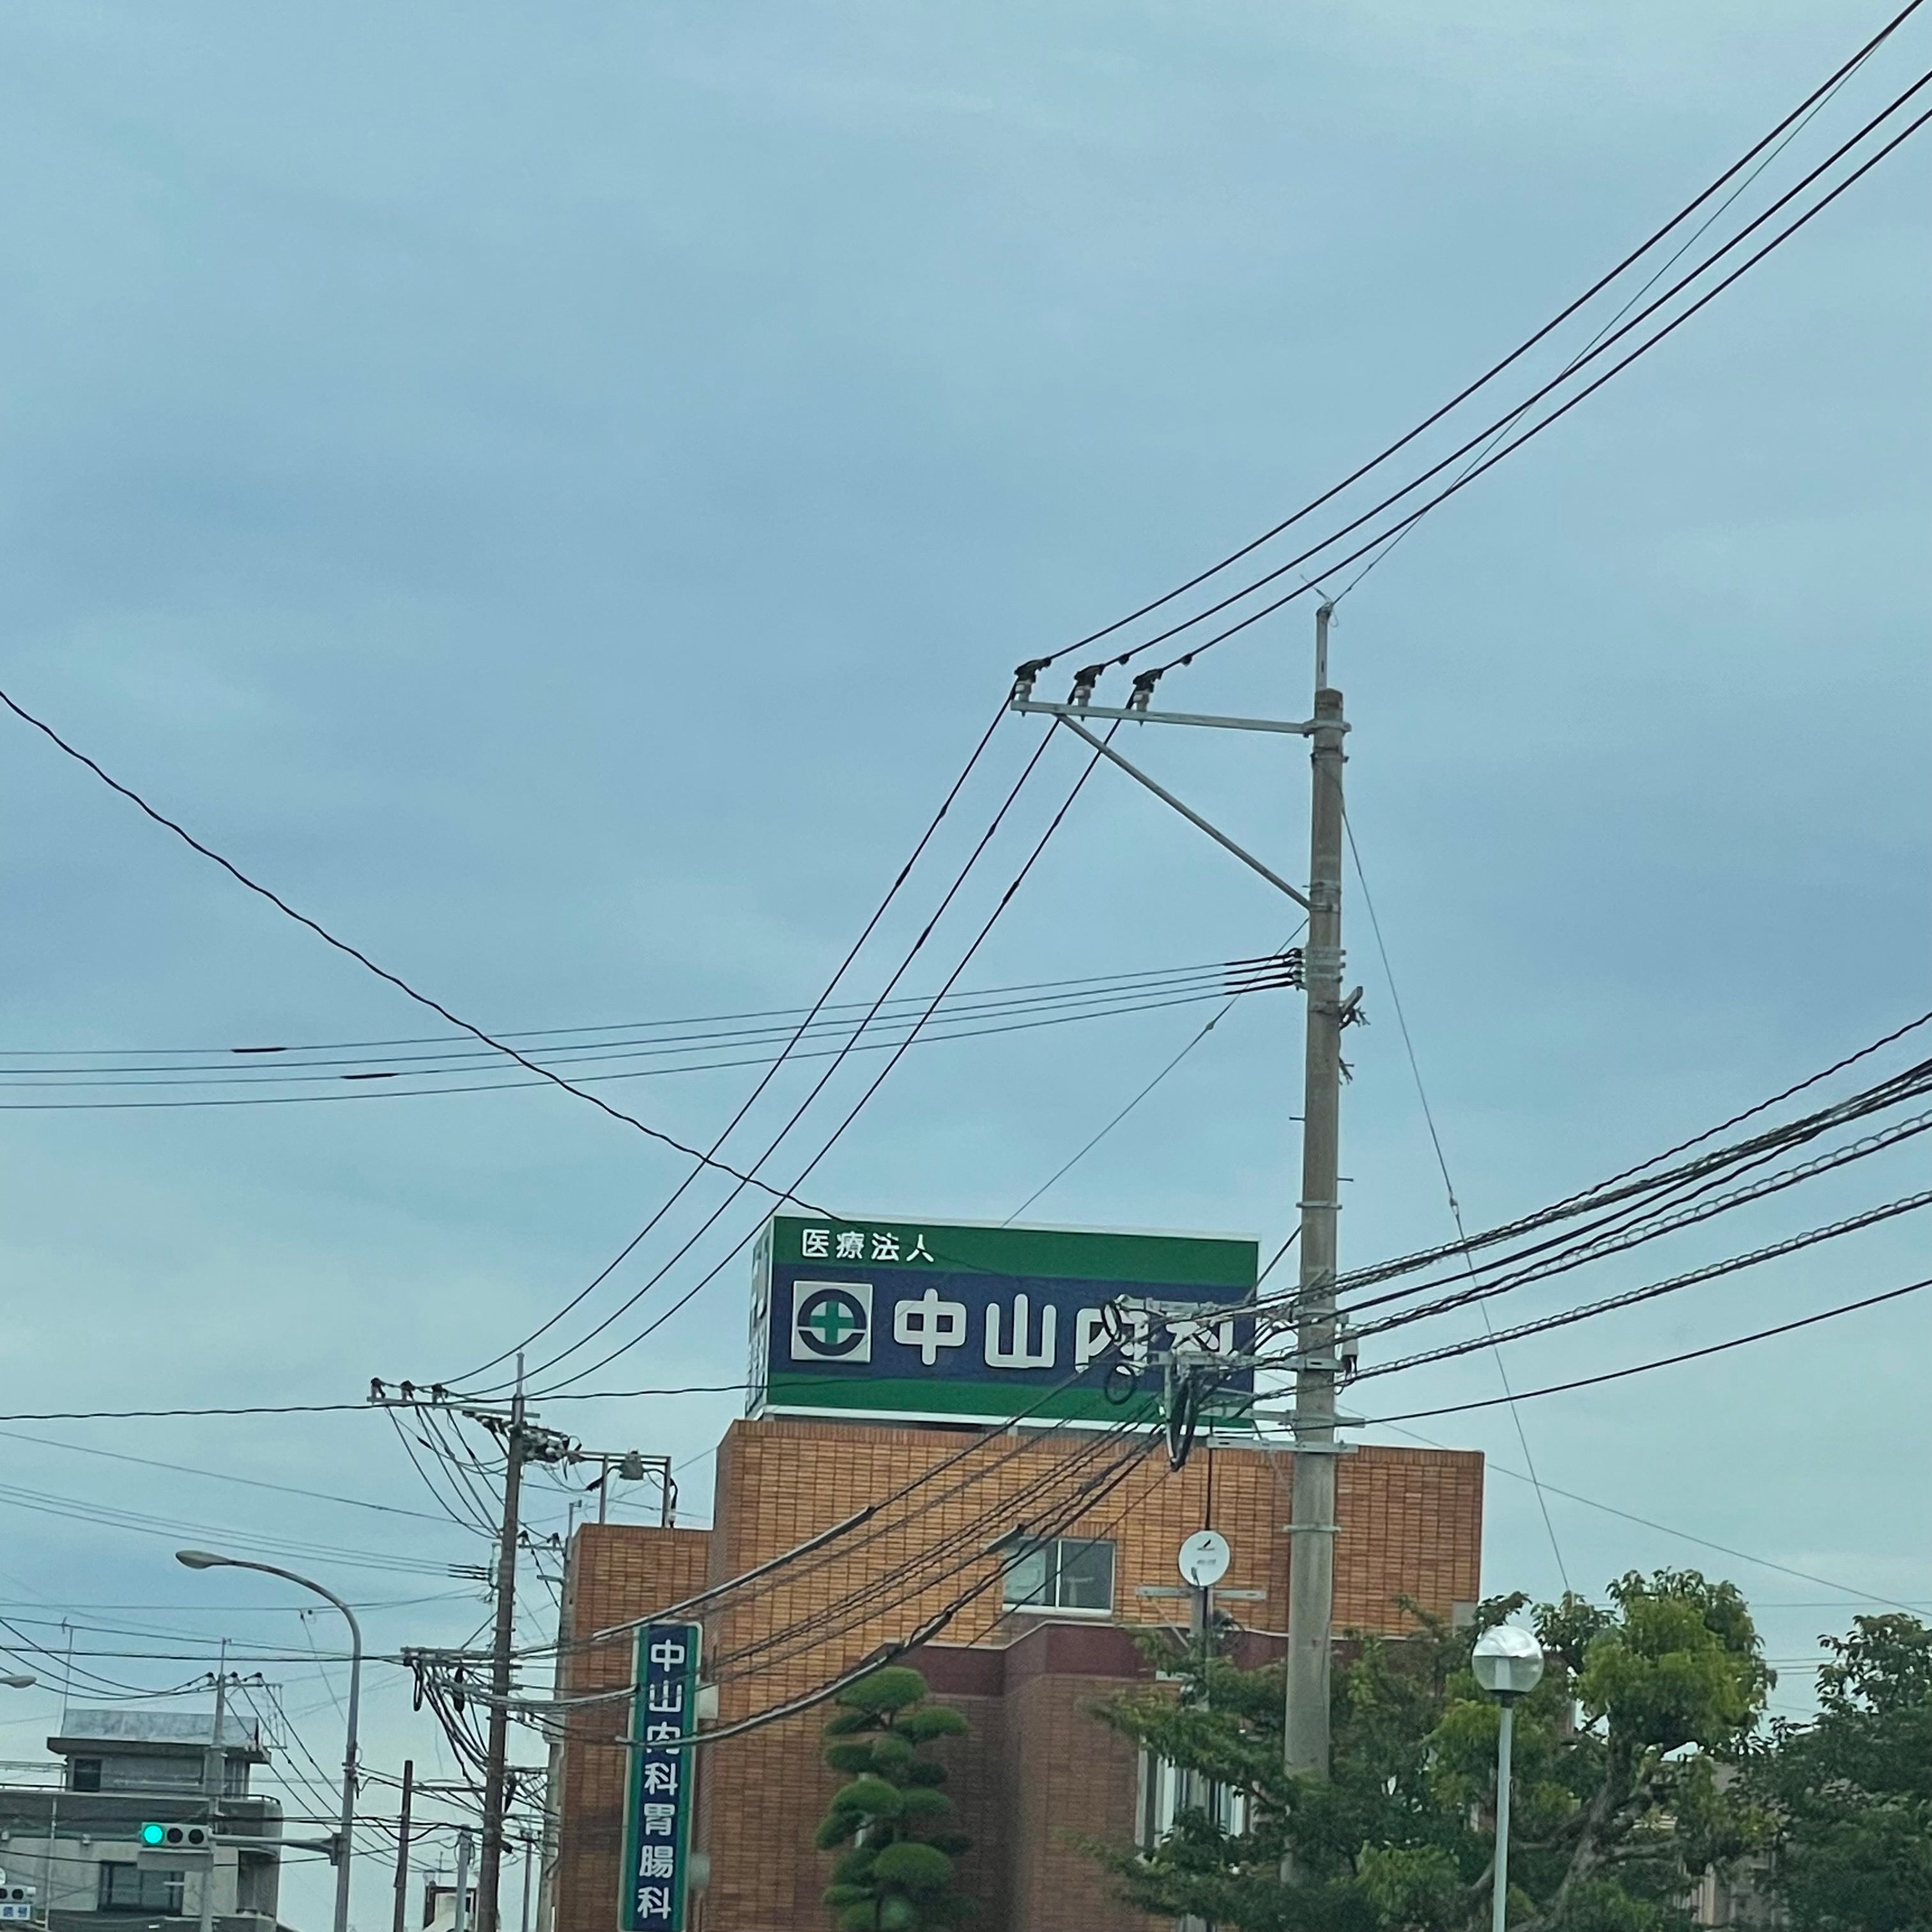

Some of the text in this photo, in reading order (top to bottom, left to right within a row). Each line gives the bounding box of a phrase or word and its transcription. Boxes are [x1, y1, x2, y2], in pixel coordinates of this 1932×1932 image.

[802, 1229, 934, 1262] 医療法人
[637, 1639, 685, 1919] 中山内科胃腸科
